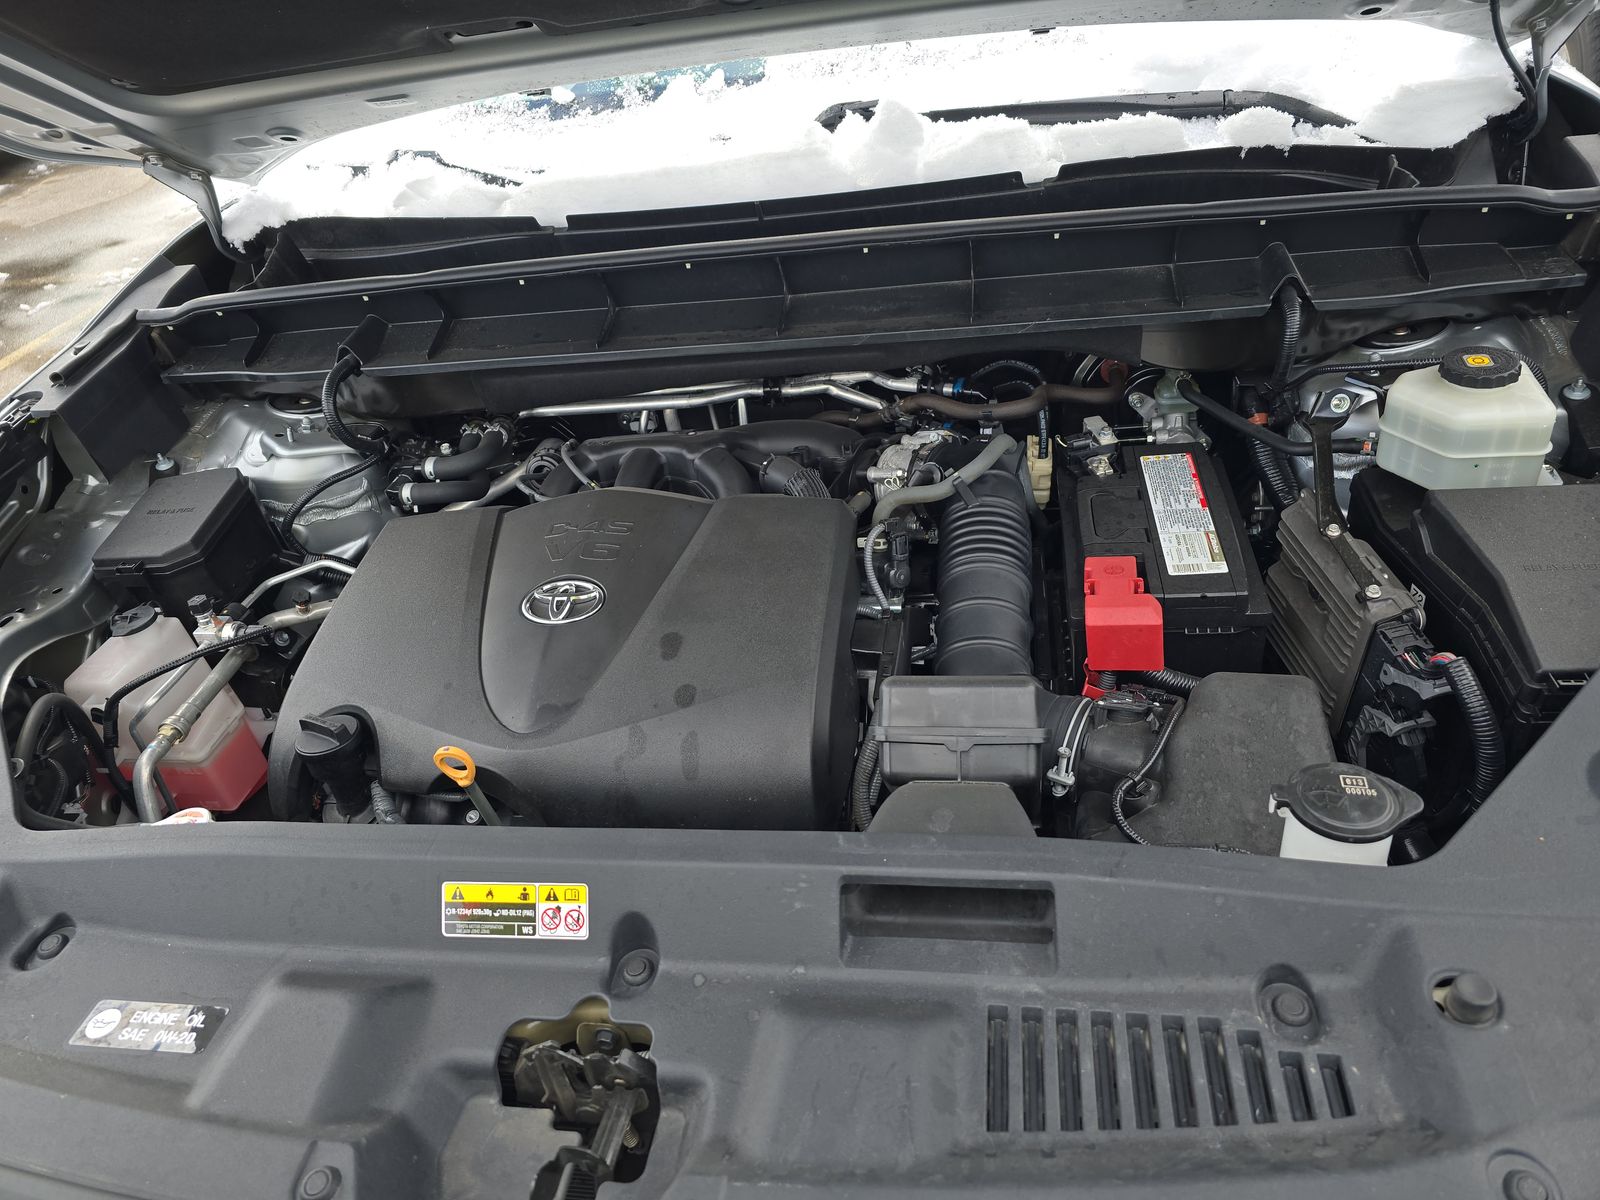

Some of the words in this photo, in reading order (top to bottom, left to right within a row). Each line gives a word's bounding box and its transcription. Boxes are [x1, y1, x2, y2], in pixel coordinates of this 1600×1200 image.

[544, 540, 620, 562] V6
[521, 926, 534, 935] WS
[129, 1010, 180, 1026] ENGINE
[185, 1014, 205, 1028] OIL
[118, 1027, 150, 1042] SAE
[153, 1031, 197, 1045] 0W-20
